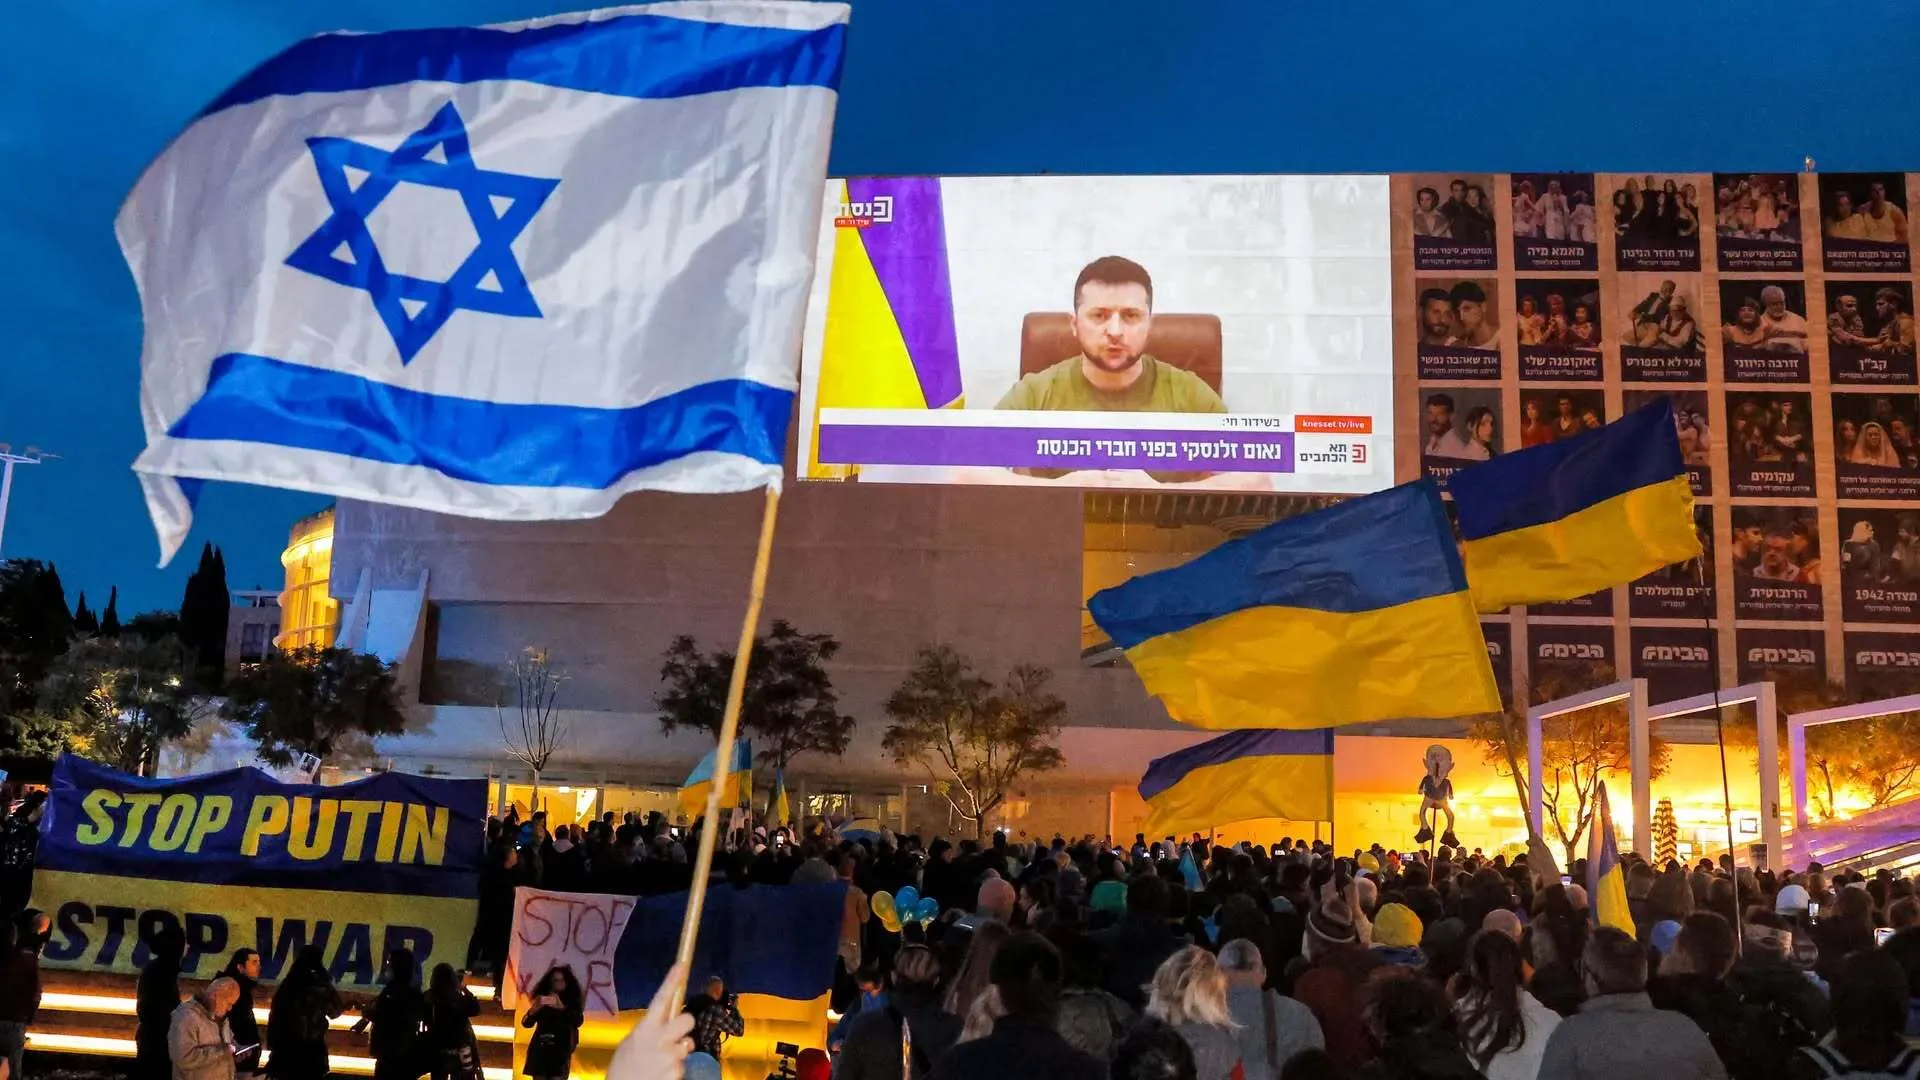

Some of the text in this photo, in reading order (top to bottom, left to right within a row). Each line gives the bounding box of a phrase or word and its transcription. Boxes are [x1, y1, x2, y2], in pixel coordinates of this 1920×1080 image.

[1527, 248, 1584, 257] מאמא מיה
[1420, 357, 1498, 365] את שאהבה נפשי
[1524, 355, 1597, 369] זאקופנה שלי
[1668, 356, 1681, 367] לא
[1683, 359, 1702, 368] אני
[1768, 360, 1799, 368] זורבה
[1222, 417, 1280, 427] בשידור חי:
[1036, 438, 1281, 461] נאום זלנסקי בפני חברי הכנסת
[1329, 443, 1347, 453] תא
[1300, 453, 1347, 463] הכתבים
[1751, 472, 1795, 484] עקומים
[1635, 585, 1684, 597] מושלמים
[1855, 590, 1917, 601] מצדה 1942
[76, 789, 450, 866] STOP PUTIN
[518, 896, 634, 954] STOP
[508, 957, 616, 1016] WR
